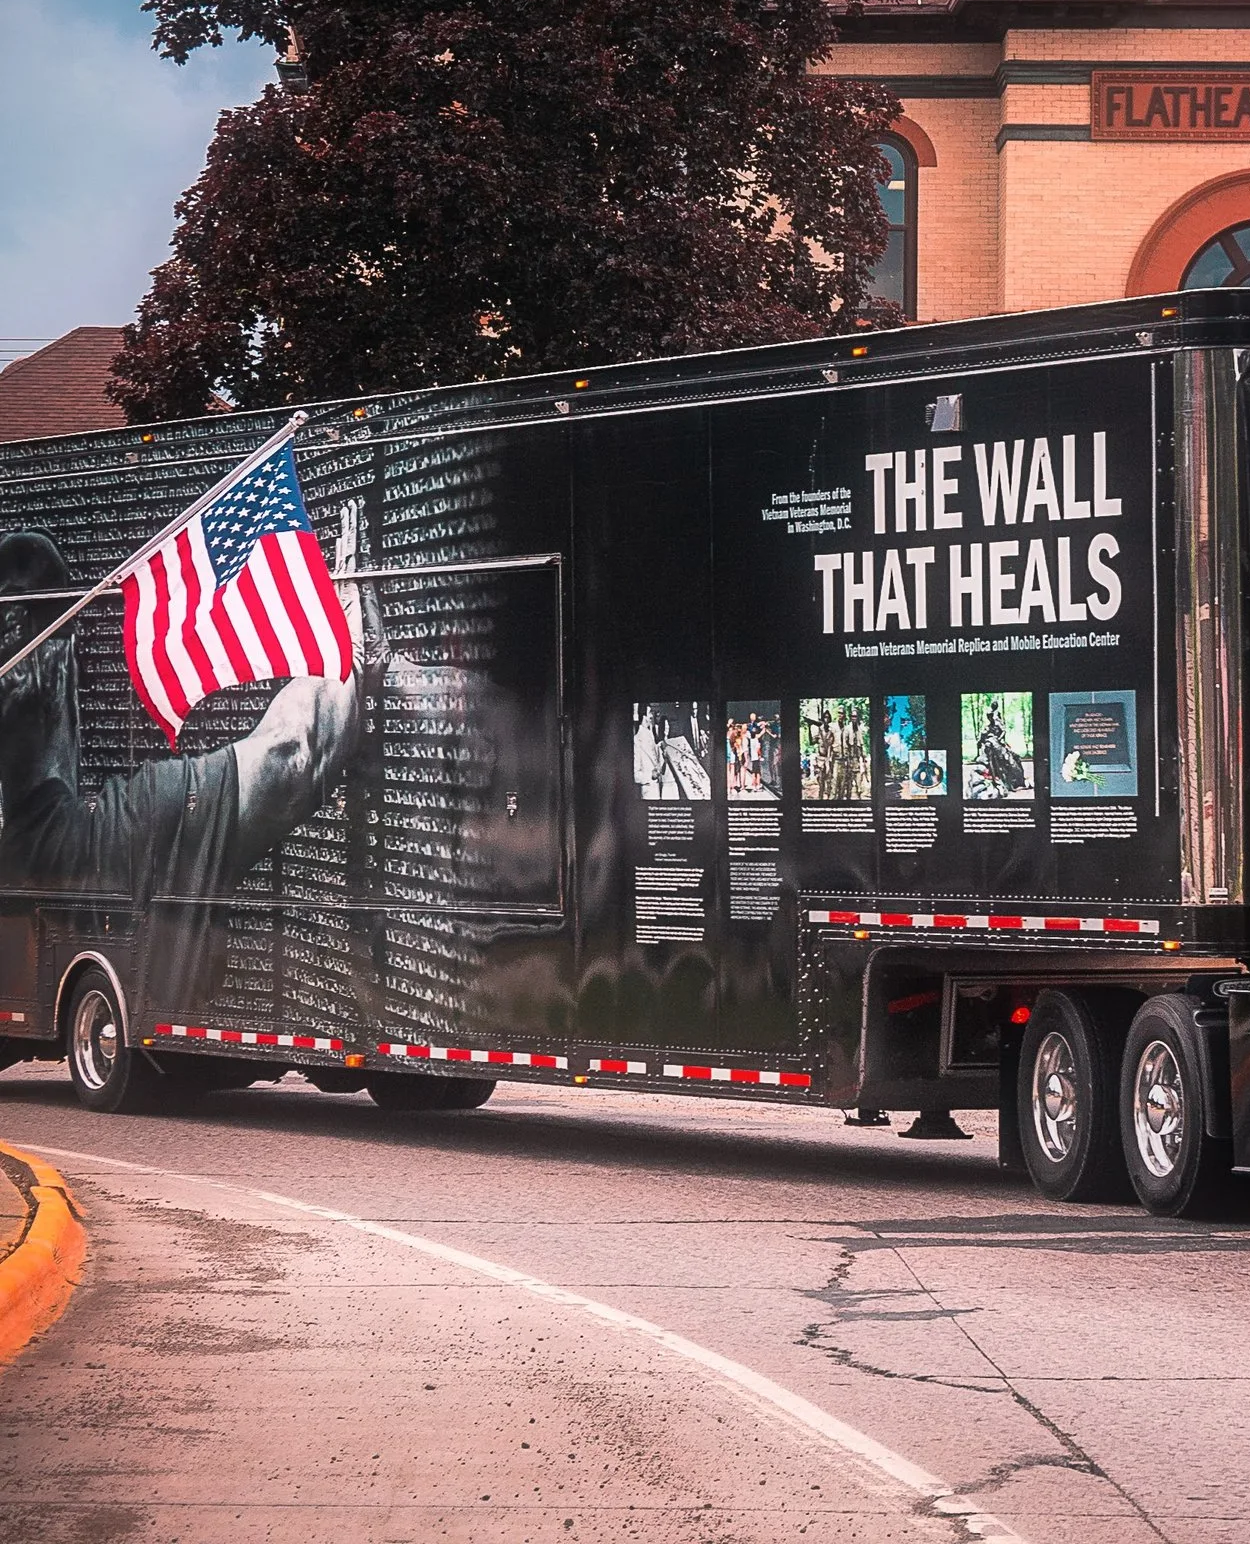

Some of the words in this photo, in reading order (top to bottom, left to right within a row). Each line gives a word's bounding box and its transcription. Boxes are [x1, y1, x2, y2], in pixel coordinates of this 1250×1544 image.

[865, 445, 963, 535] THE
[973, 431, 1123, 527] WALL
[771, 493, 788, 505] From
[789, 491, 801, 503] the
[801, 489, 830, 503] founders
[832, 487, 839, 500] of
[840, 486, 852, 500] the
[761, 508, 789, 521] Vietnam
[789, 506, 819, 518] Veterans
[820, 501, 852, 516] Memorial
[787, 522, 794, 533] in
[795, 519, 836, 534] Washington,
[837, 517, 852, 530] D.C.
[814, 546, 935, 634] THAT
[949, 532, 1122, 627] HEALS
[844, 643, 879, 658] Vietnam
[879, 641, 915, 656] Veterans
[916, 638, 957, 655] Memorial
[958, 637, 991, 655] Replica
[992, 636, 1009, 651] and
[1010, 635, 1041, 651] Mobile
[1042, 632, 1088, 649] Education
[1089, 631, 1120, 647] Center
